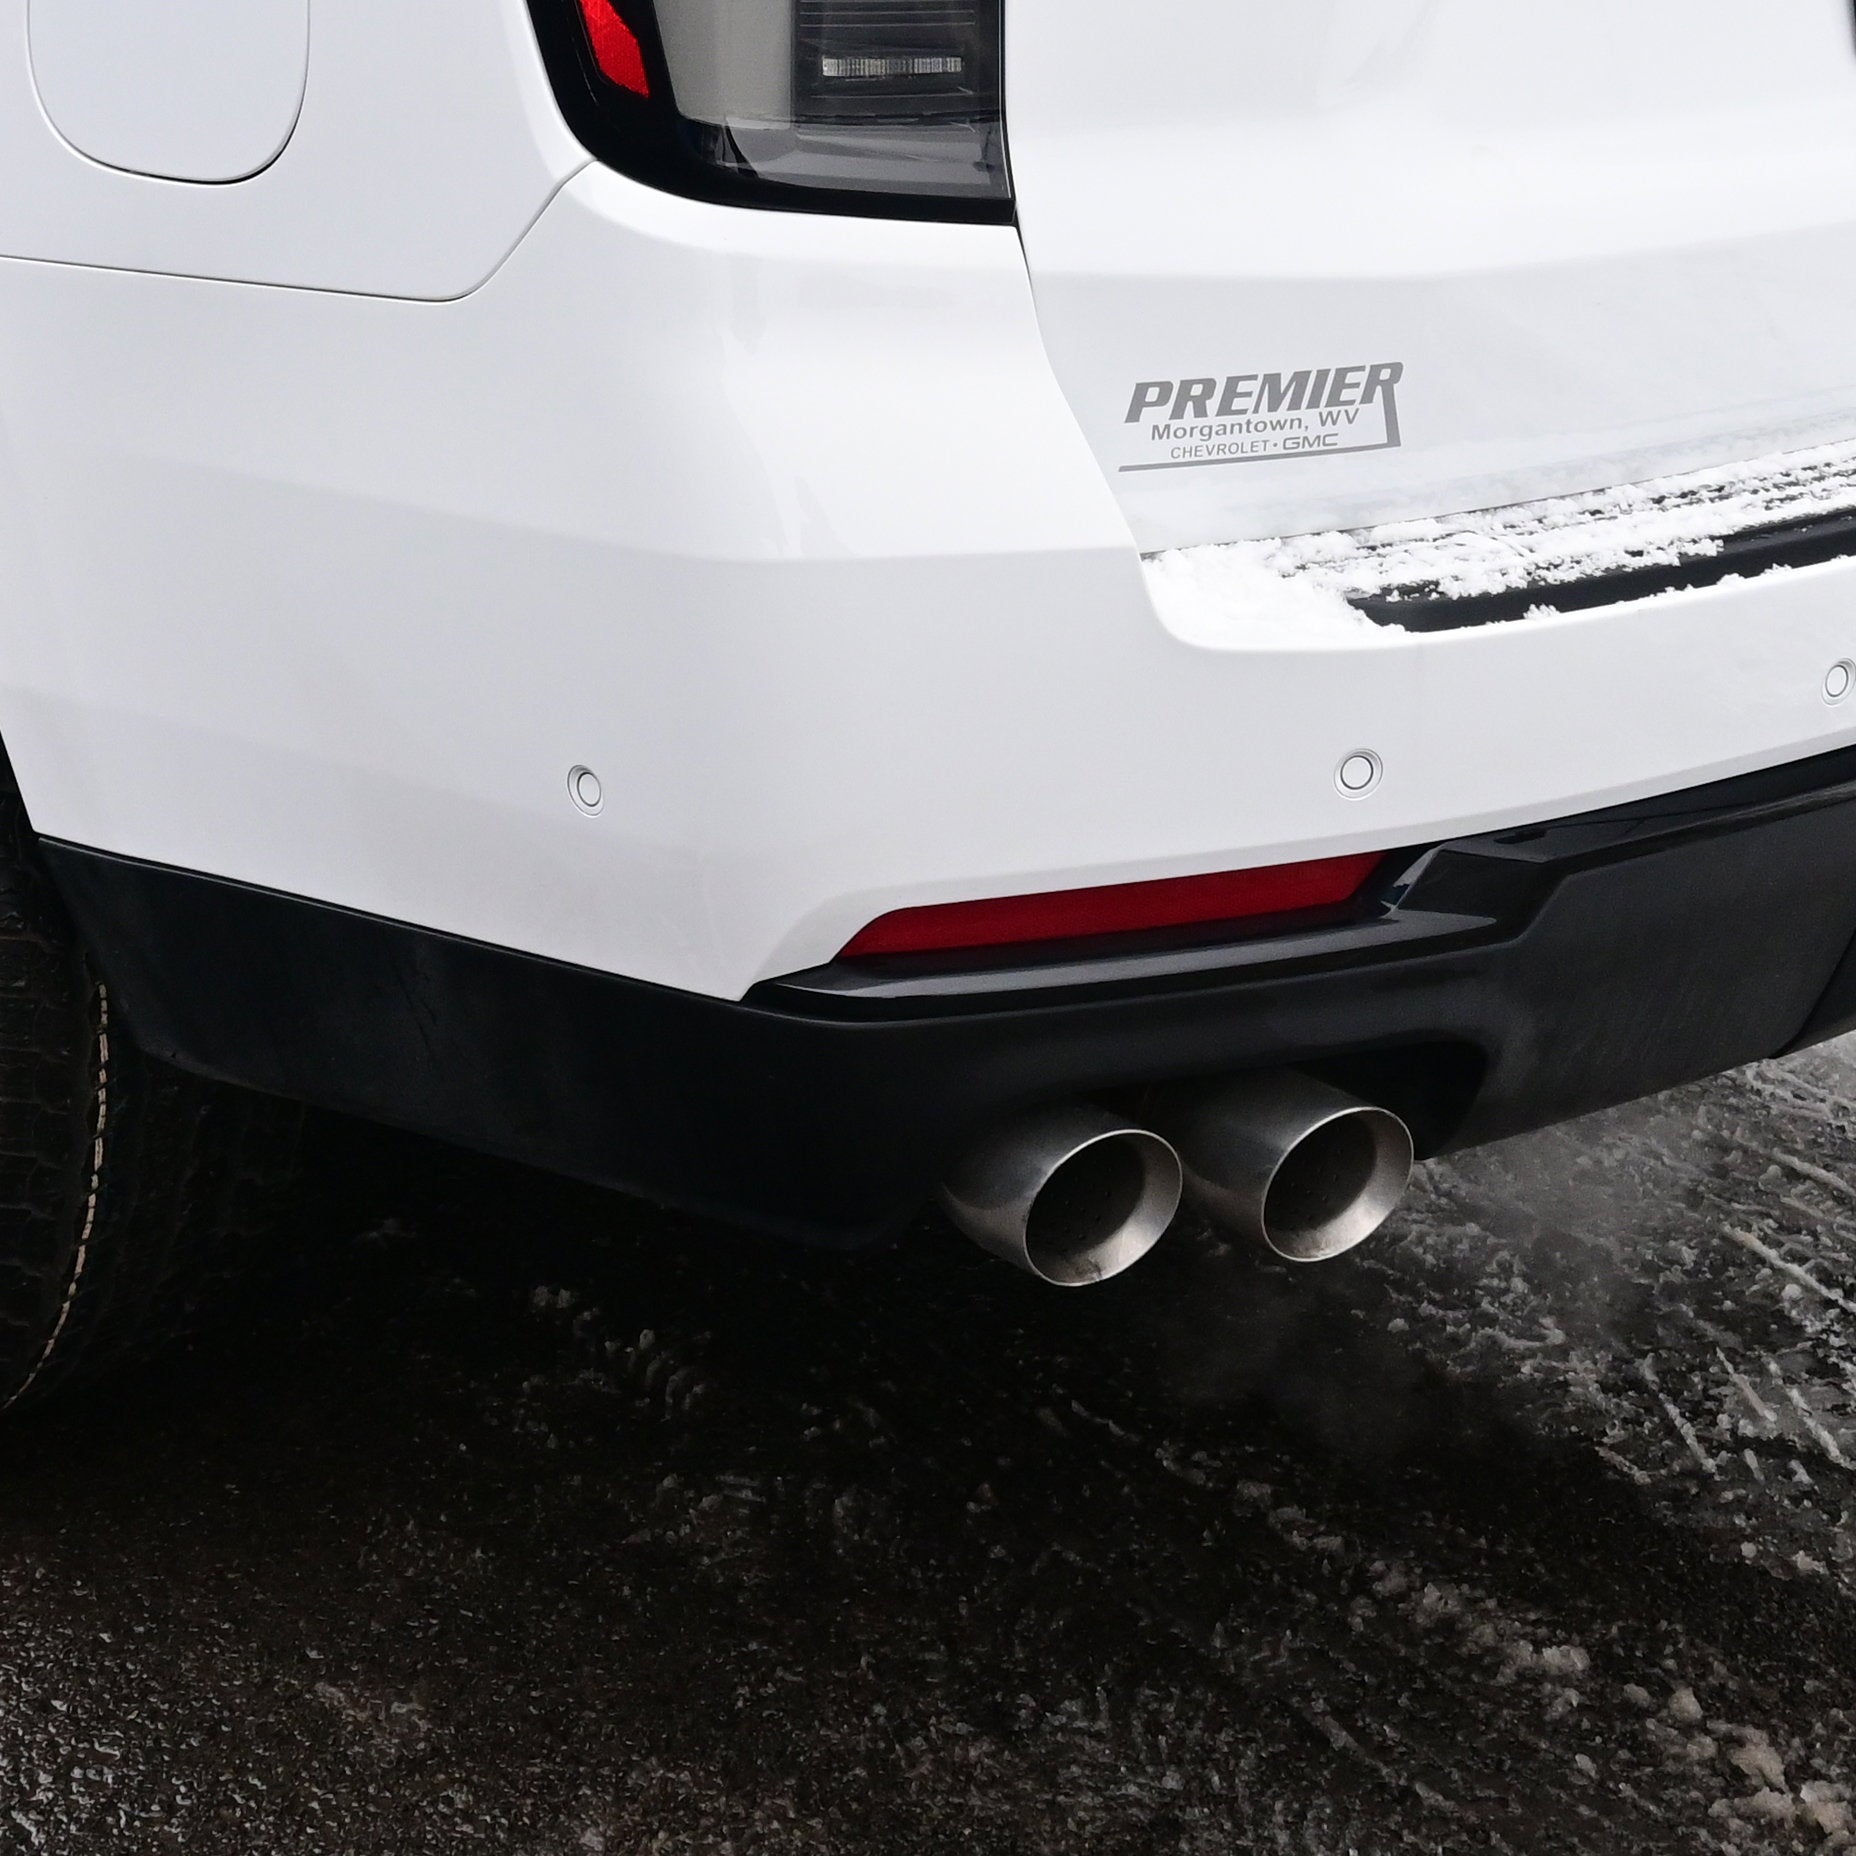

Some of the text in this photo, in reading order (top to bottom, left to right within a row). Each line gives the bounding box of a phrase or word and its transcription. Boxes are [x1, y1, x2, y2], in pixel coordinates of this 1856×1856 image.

[1123, 361, 1404, 428] PREMIER
[1150, 407, 1360, 442] Morgantown, WV
[1170, 432, 1339, 460] CHEVROLET GMC
